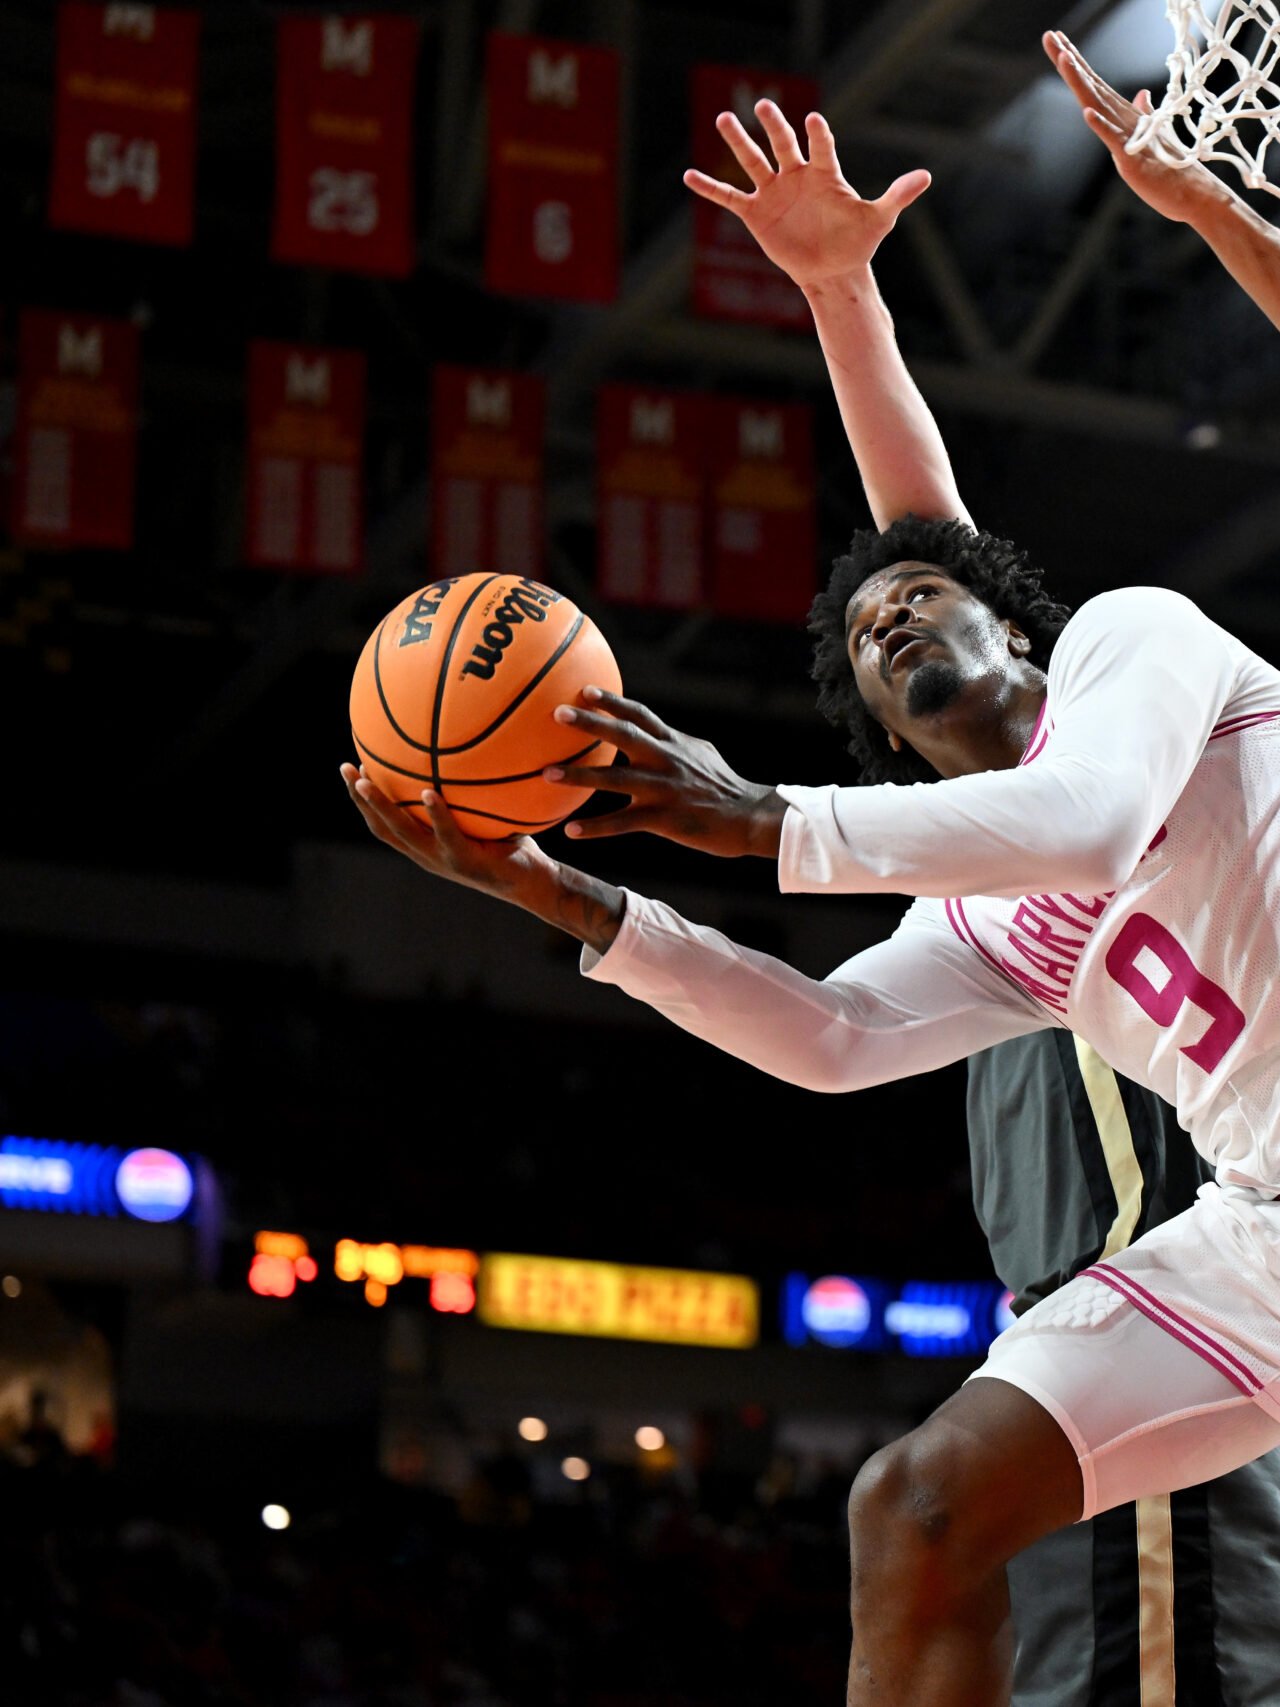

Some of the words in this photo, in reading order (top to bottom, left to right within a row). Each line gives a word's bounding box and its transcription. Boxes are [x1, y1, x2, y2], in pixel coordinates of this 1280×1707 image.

[322, 15, 373, 75] M
[528, 50, 578, 106] M
[86, 132, 159, 203] 54
[307, 167, 379, 235] 25
[533, 200, 573, 263] 6
[58, 324, 102, 374] M
[286, 355, 330, 402] M
[466, 377, 510, 425] M
[630, 400, 674, 445] M
[738, 412, 782, 457] M
[399, 578, 459, 647] CAA
[1105, 911, 1247, 1076] 9
